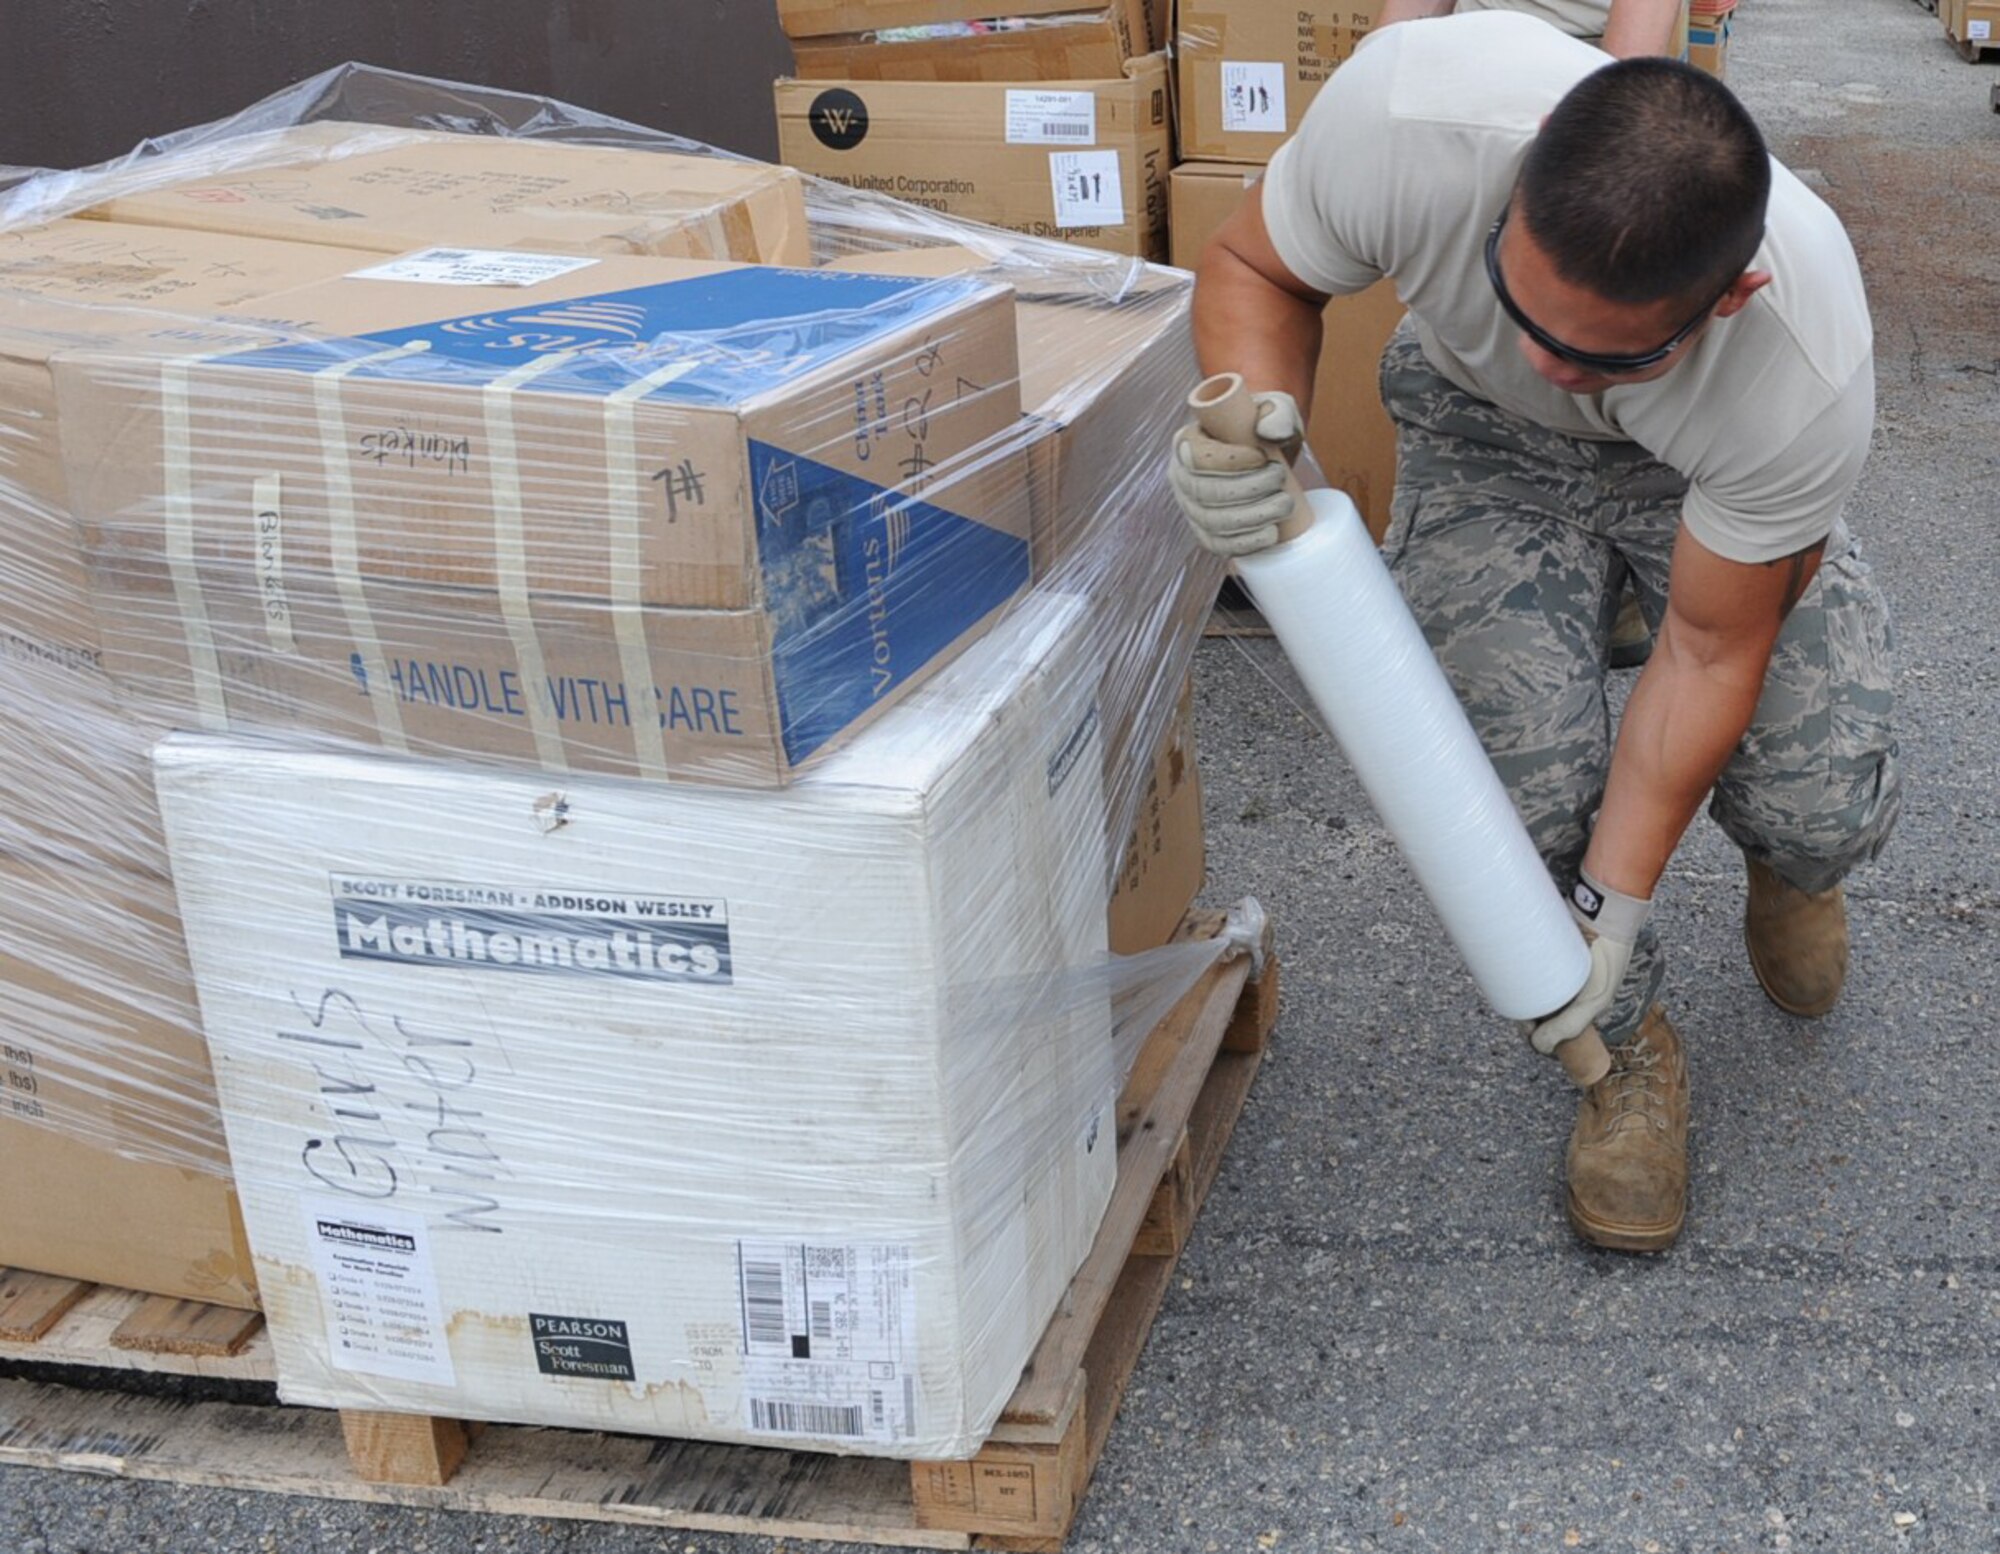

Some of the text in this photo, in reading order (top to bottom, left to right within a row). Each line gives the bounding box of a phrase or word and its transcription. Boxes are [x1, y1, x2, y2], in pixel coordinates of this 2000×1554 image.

[852, 174, 894, 191] United
[896, 175, 975, 195] Corporation
[1033, 220, 1102, 241] Sharpener
[855, 381, 870, 461] China
[389, 658, 525, 717] HANDLE
[645, 685, 744, 737] ARE
[341, 879, 715, 919] SCOTT FORESMAN ADDISON WESLEY
[345, 911, 721, 976] Mathematics
[276, 987, 398, 1199] Girls
[320, 1223, 414, 1250] Mathematics
[535, 1318, 623, 1339] PEARSON
[540, 1341, 582, 1358] Scott
[551, 1356, 630, 1376] Foresman
